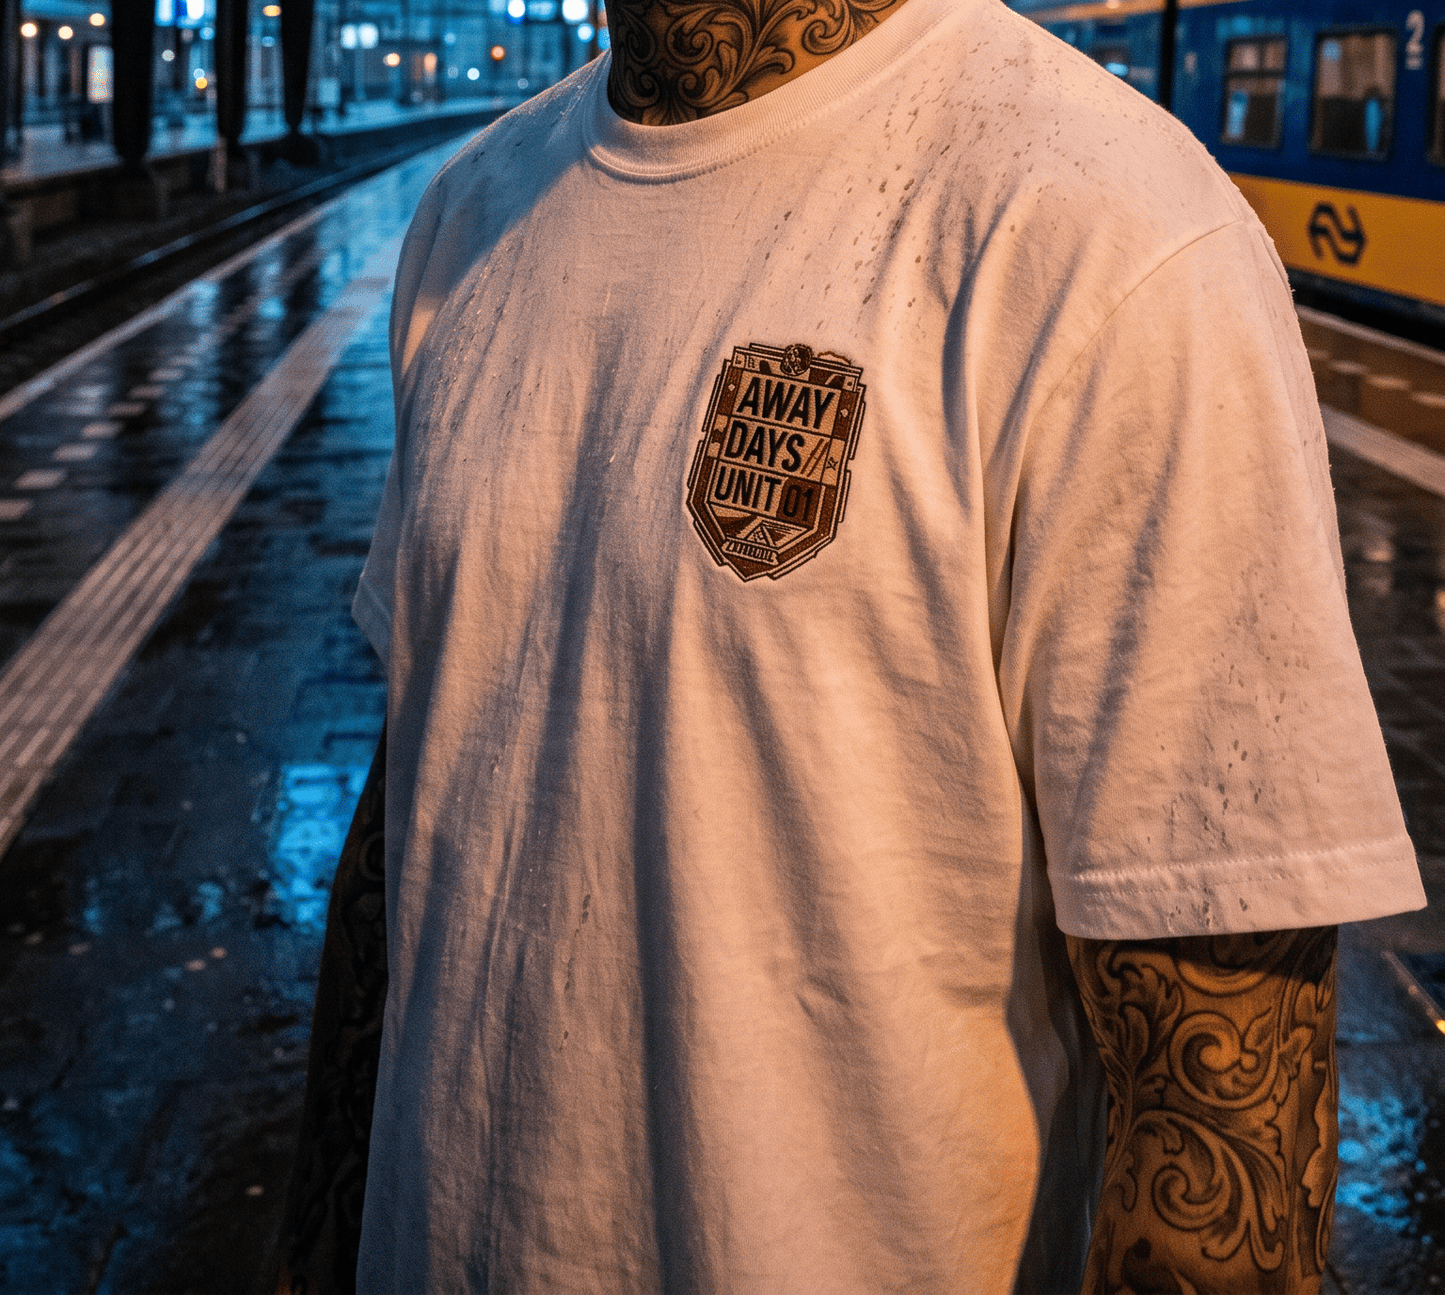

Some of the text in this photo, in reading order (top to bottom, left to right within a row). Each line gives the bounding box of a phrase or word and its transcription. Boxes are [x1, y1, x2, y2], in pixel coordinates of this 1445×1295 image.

[1404, 9, 1425, 59] 2
[736, 376, 835, 430] AWAY
[724, 419, 805, 473] DAYS
[713, 466, 814, 522] UNIT 01
